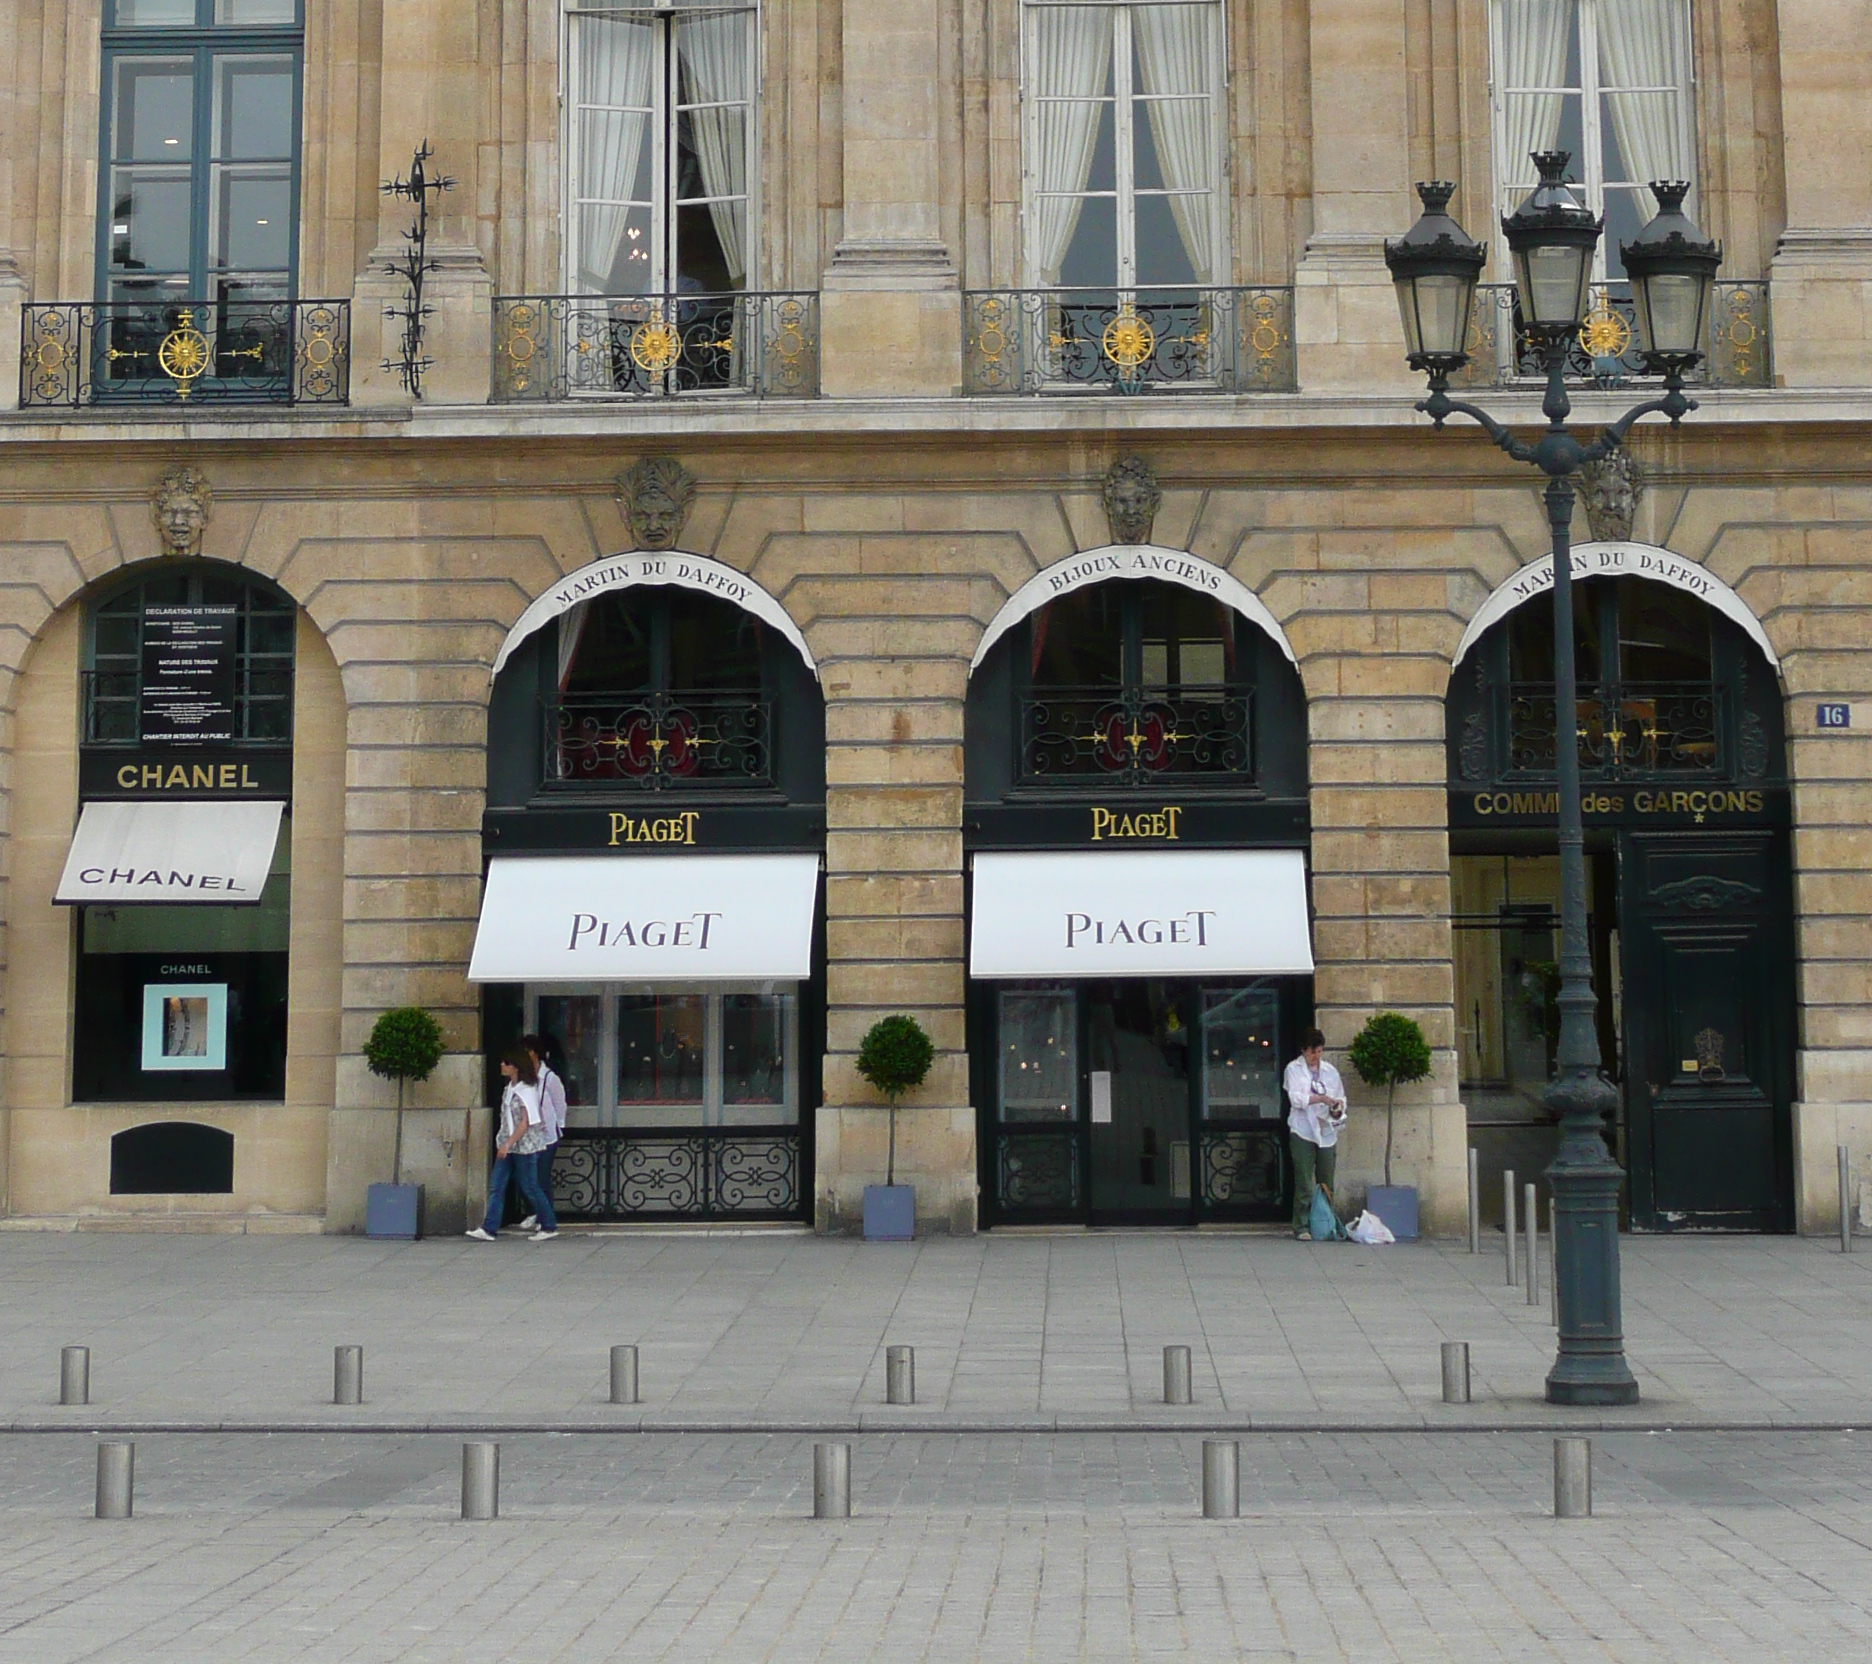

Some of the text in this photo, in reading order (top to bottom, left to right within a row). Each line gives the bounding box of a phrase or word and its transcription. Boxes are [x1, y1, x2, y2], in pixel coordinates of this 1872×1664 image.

[556, 561, 754, 609] MARTIN DU DAFFOY
[1049, 554, 1222, 592] BIJOUX ANCIENS
[1598, 552, 1626, 567] DU
[1639, 554, 1716, 596] DAFFOY
[1824, 706, 1844, 725] 16
[117, 765, 259, 788] CHANEL
[1473, 792, 1561, 815] COMM
[1581, 792, 1625, 813] des
[608, 812, 700, 846] PIAGET
[1090, 806, 1182, 841] PIAGET
[79, 868, 247, 892] CHANEL
[566, 912, 723, 950] PIAGET
[1065, 911, 1217, 948] PIAGET
[160, 964, 212, 975] CHANEL
